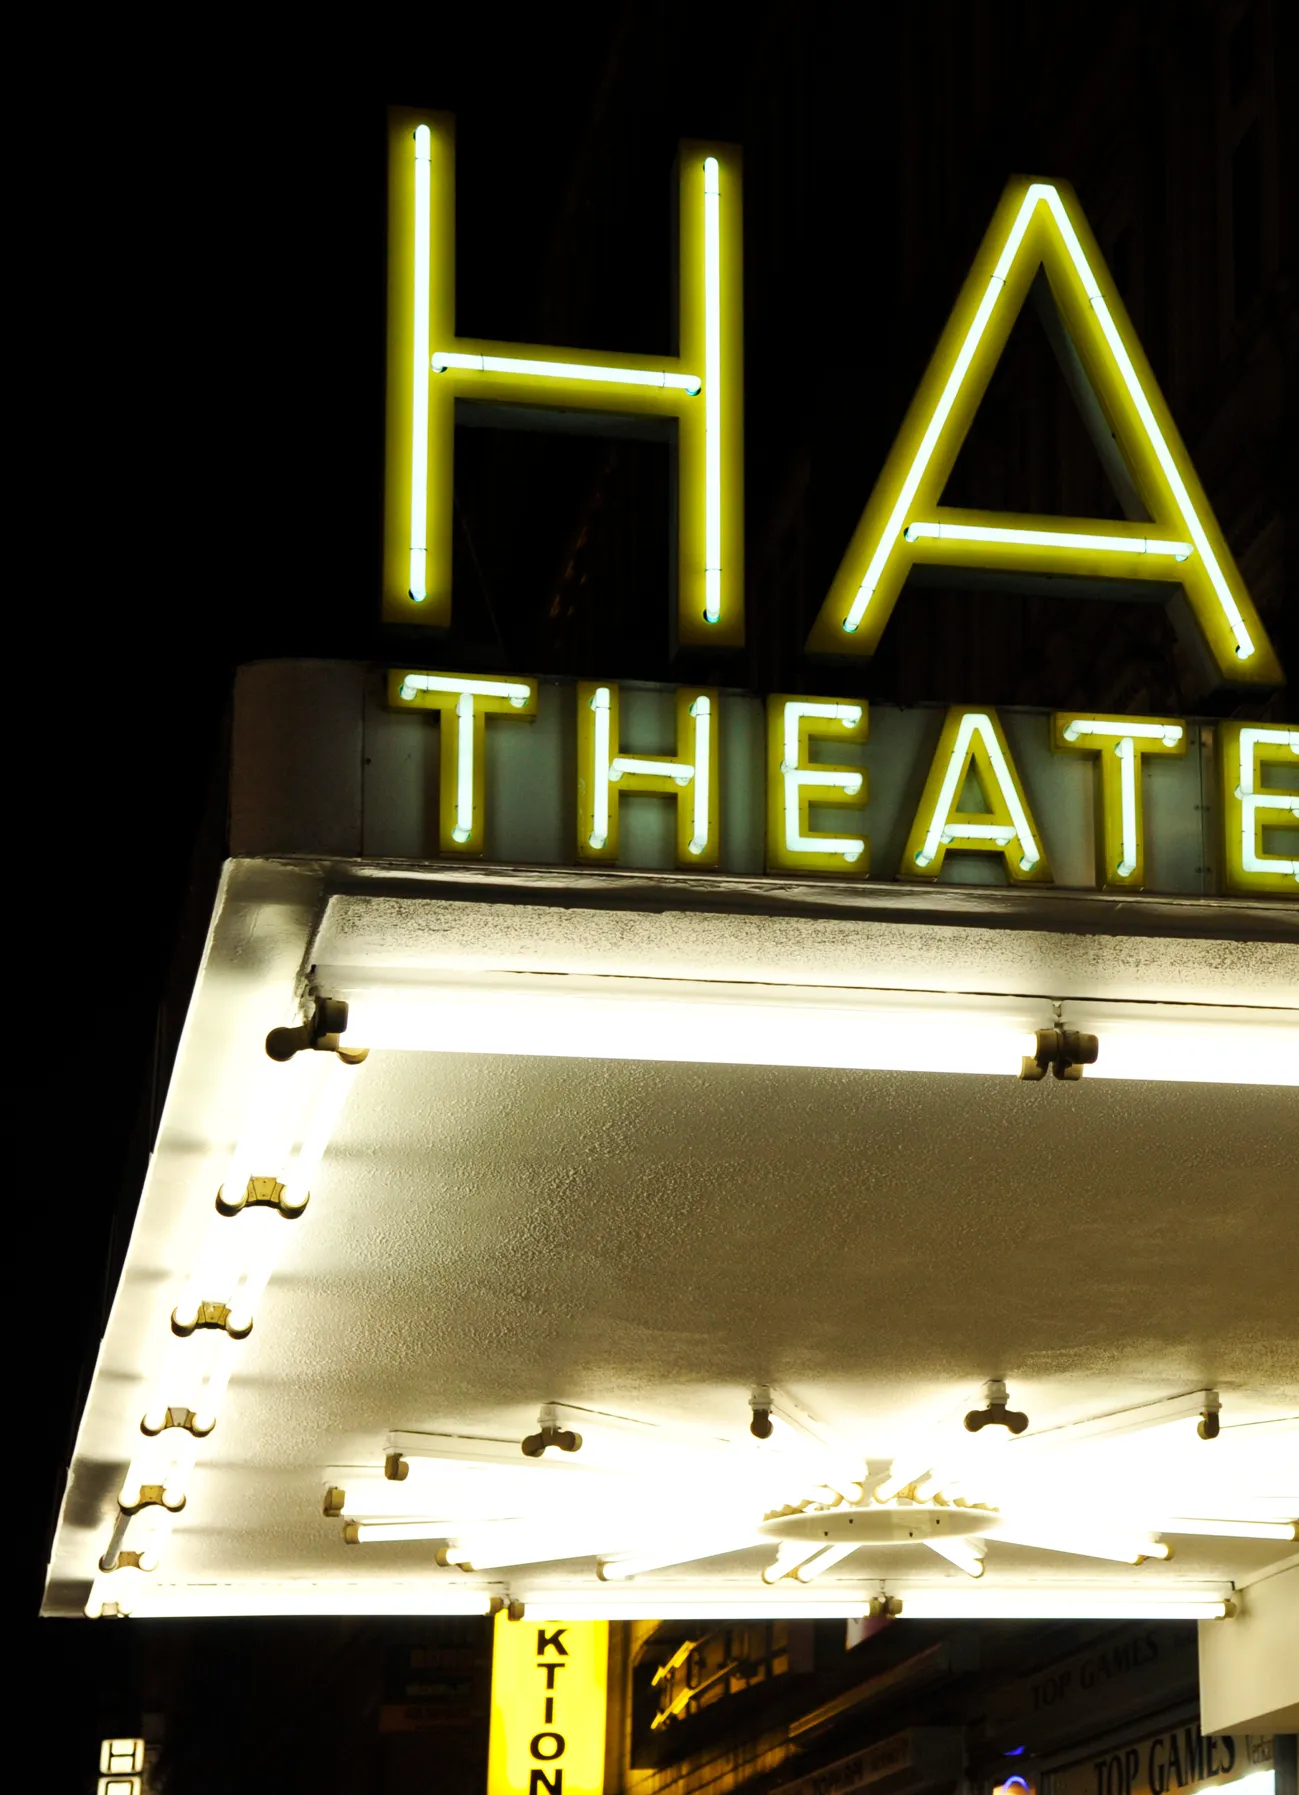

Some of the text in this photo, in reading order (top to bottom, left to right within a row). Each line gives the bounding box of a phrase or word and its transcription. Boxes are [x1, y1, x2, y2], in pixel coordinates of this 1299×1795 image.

[530, 1620, 569, 1795] KTION
[1031, 1632, 1158, 1711] TOP GAMES
[1095, 1749, 1139, 1795] TOP
